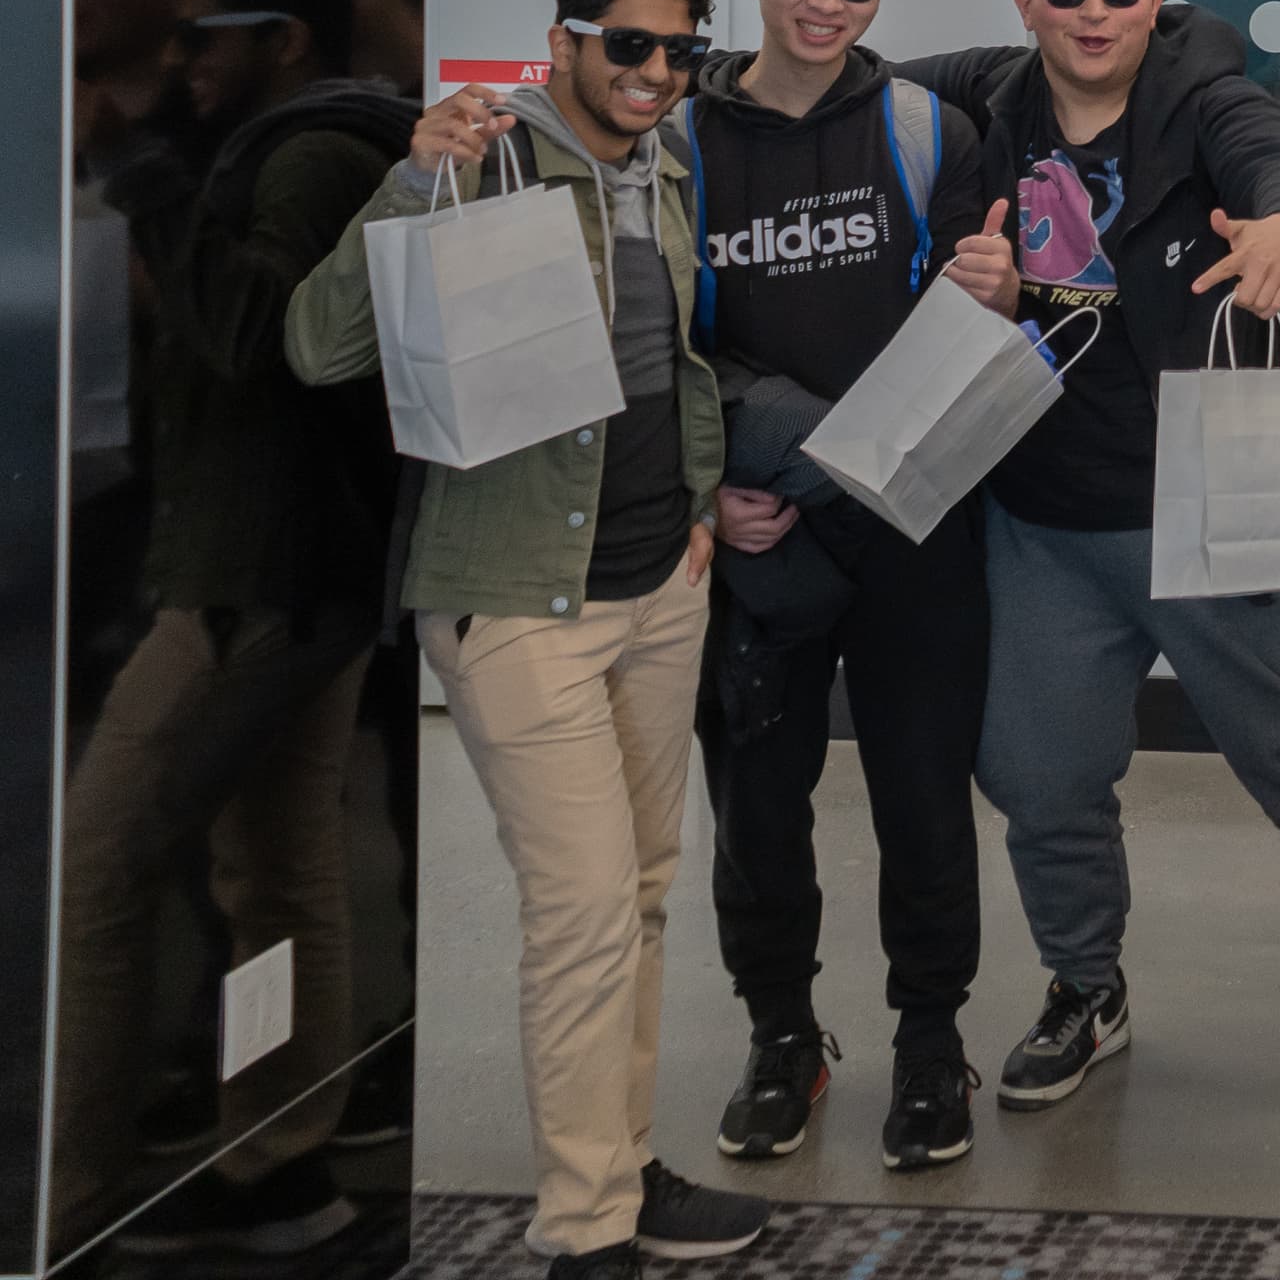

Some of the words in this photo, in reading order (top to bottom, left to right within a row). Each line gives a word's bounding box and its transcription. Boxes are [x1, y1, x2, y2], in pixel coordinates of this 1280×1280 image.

[706, 212, 877, 268] adidas
[819, 258, 834, 270] OF
[839, 250, 879, 265] SPORT
[1048, 287, 1118, 307] THETA
